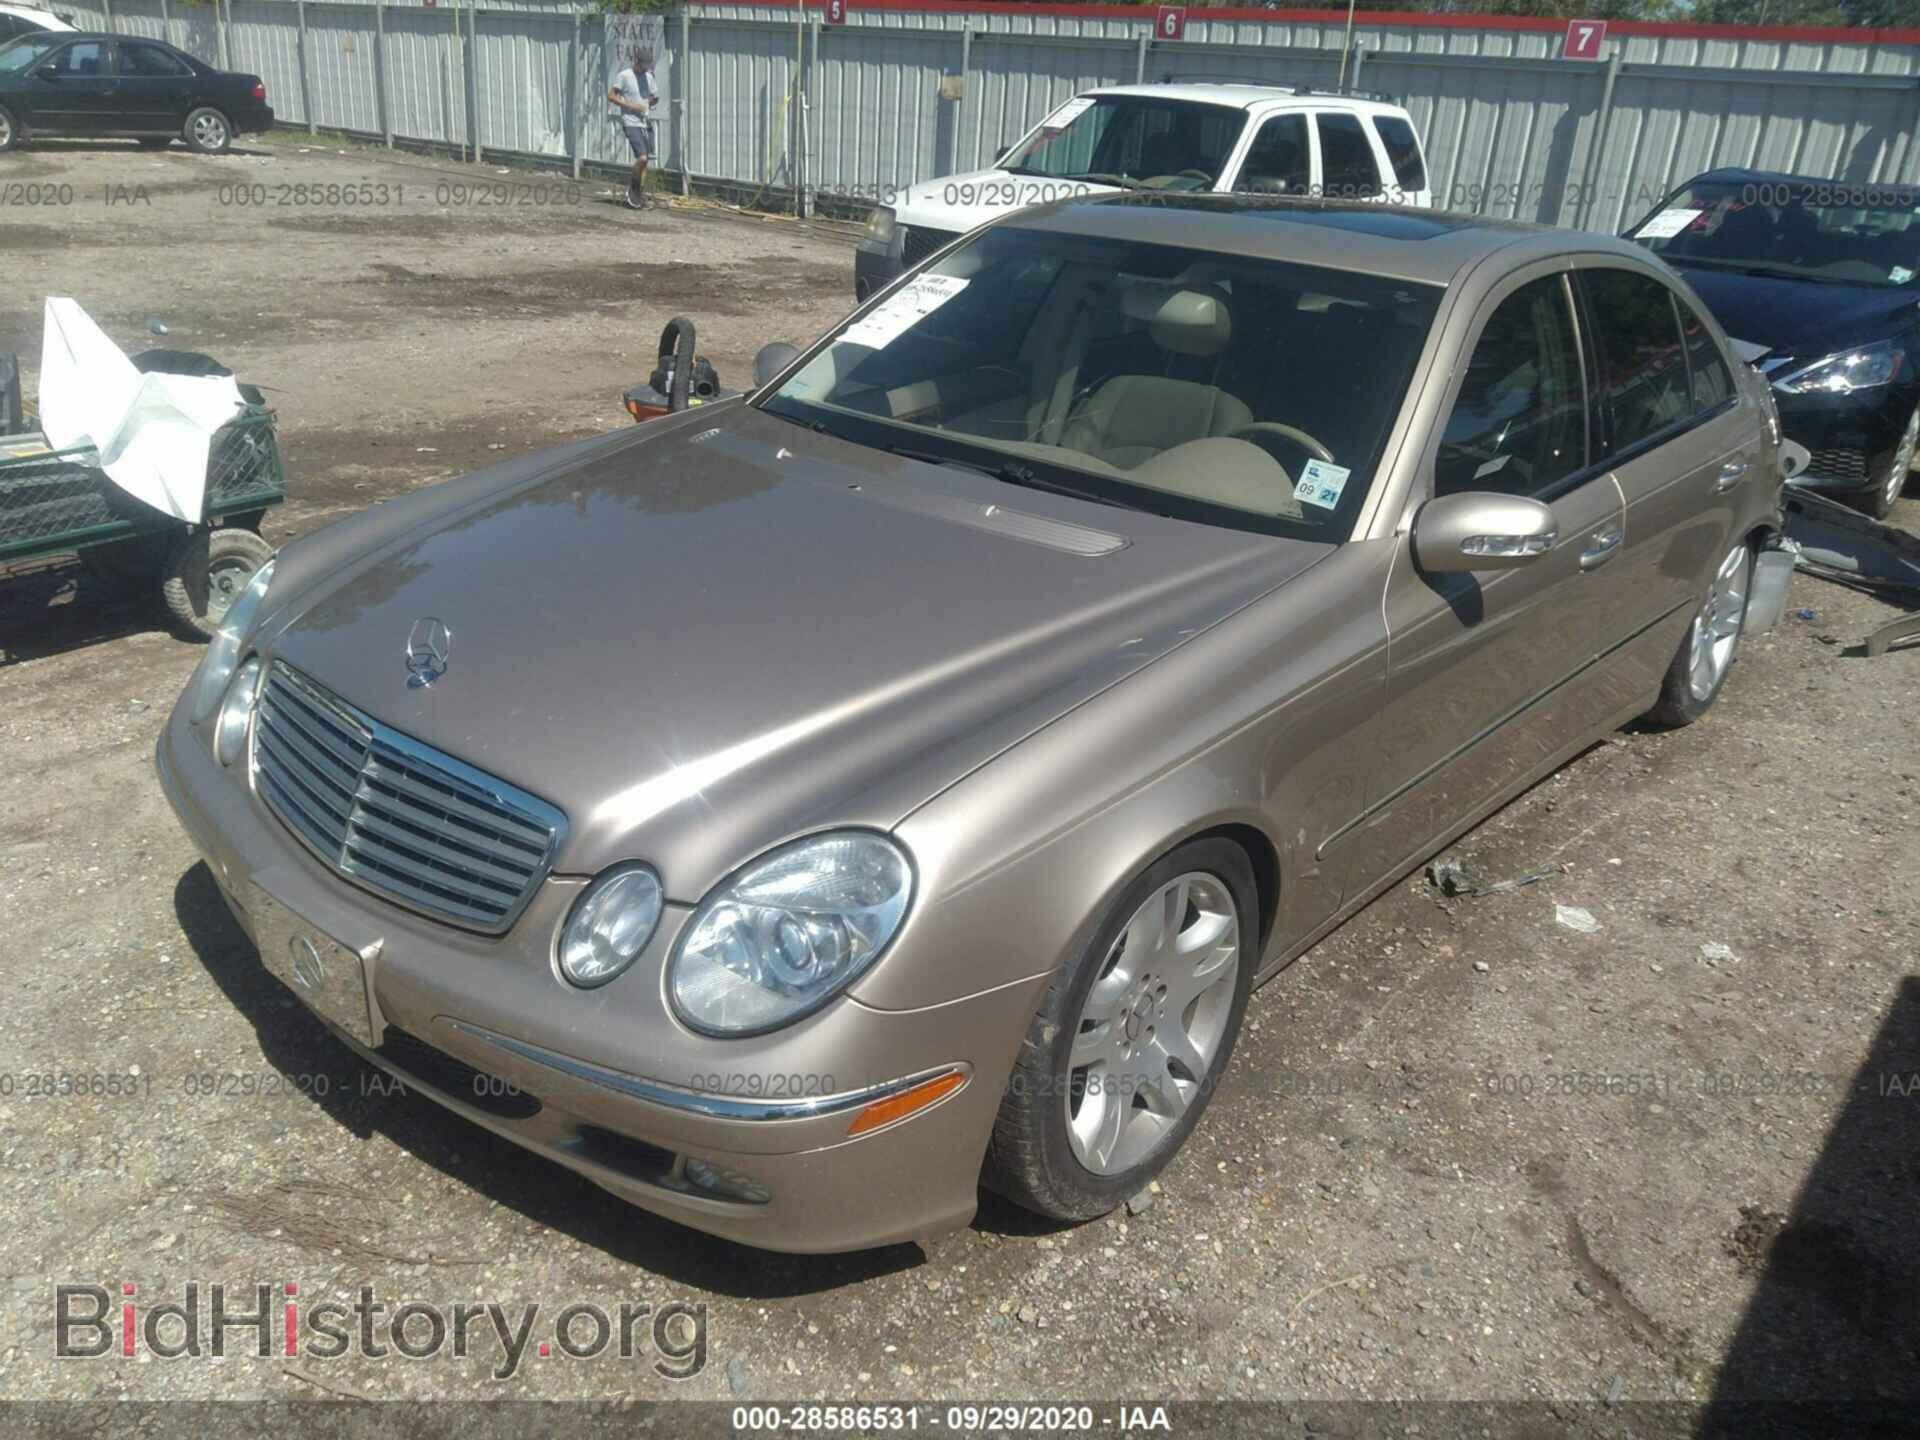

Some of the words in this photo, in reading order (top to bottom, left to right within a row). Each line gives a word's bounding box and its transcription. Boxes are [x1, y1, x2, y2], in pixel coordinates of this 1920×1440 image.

[831, 1, 841, 19] 5
[615, 21, 656, 41] STATE
[1165, 14, 1176, 35] 6
[1577, 27, 1594, 51] 7
[1300, 483, 1314, 495] 09
[1320, 489, 1337, 502] 21
